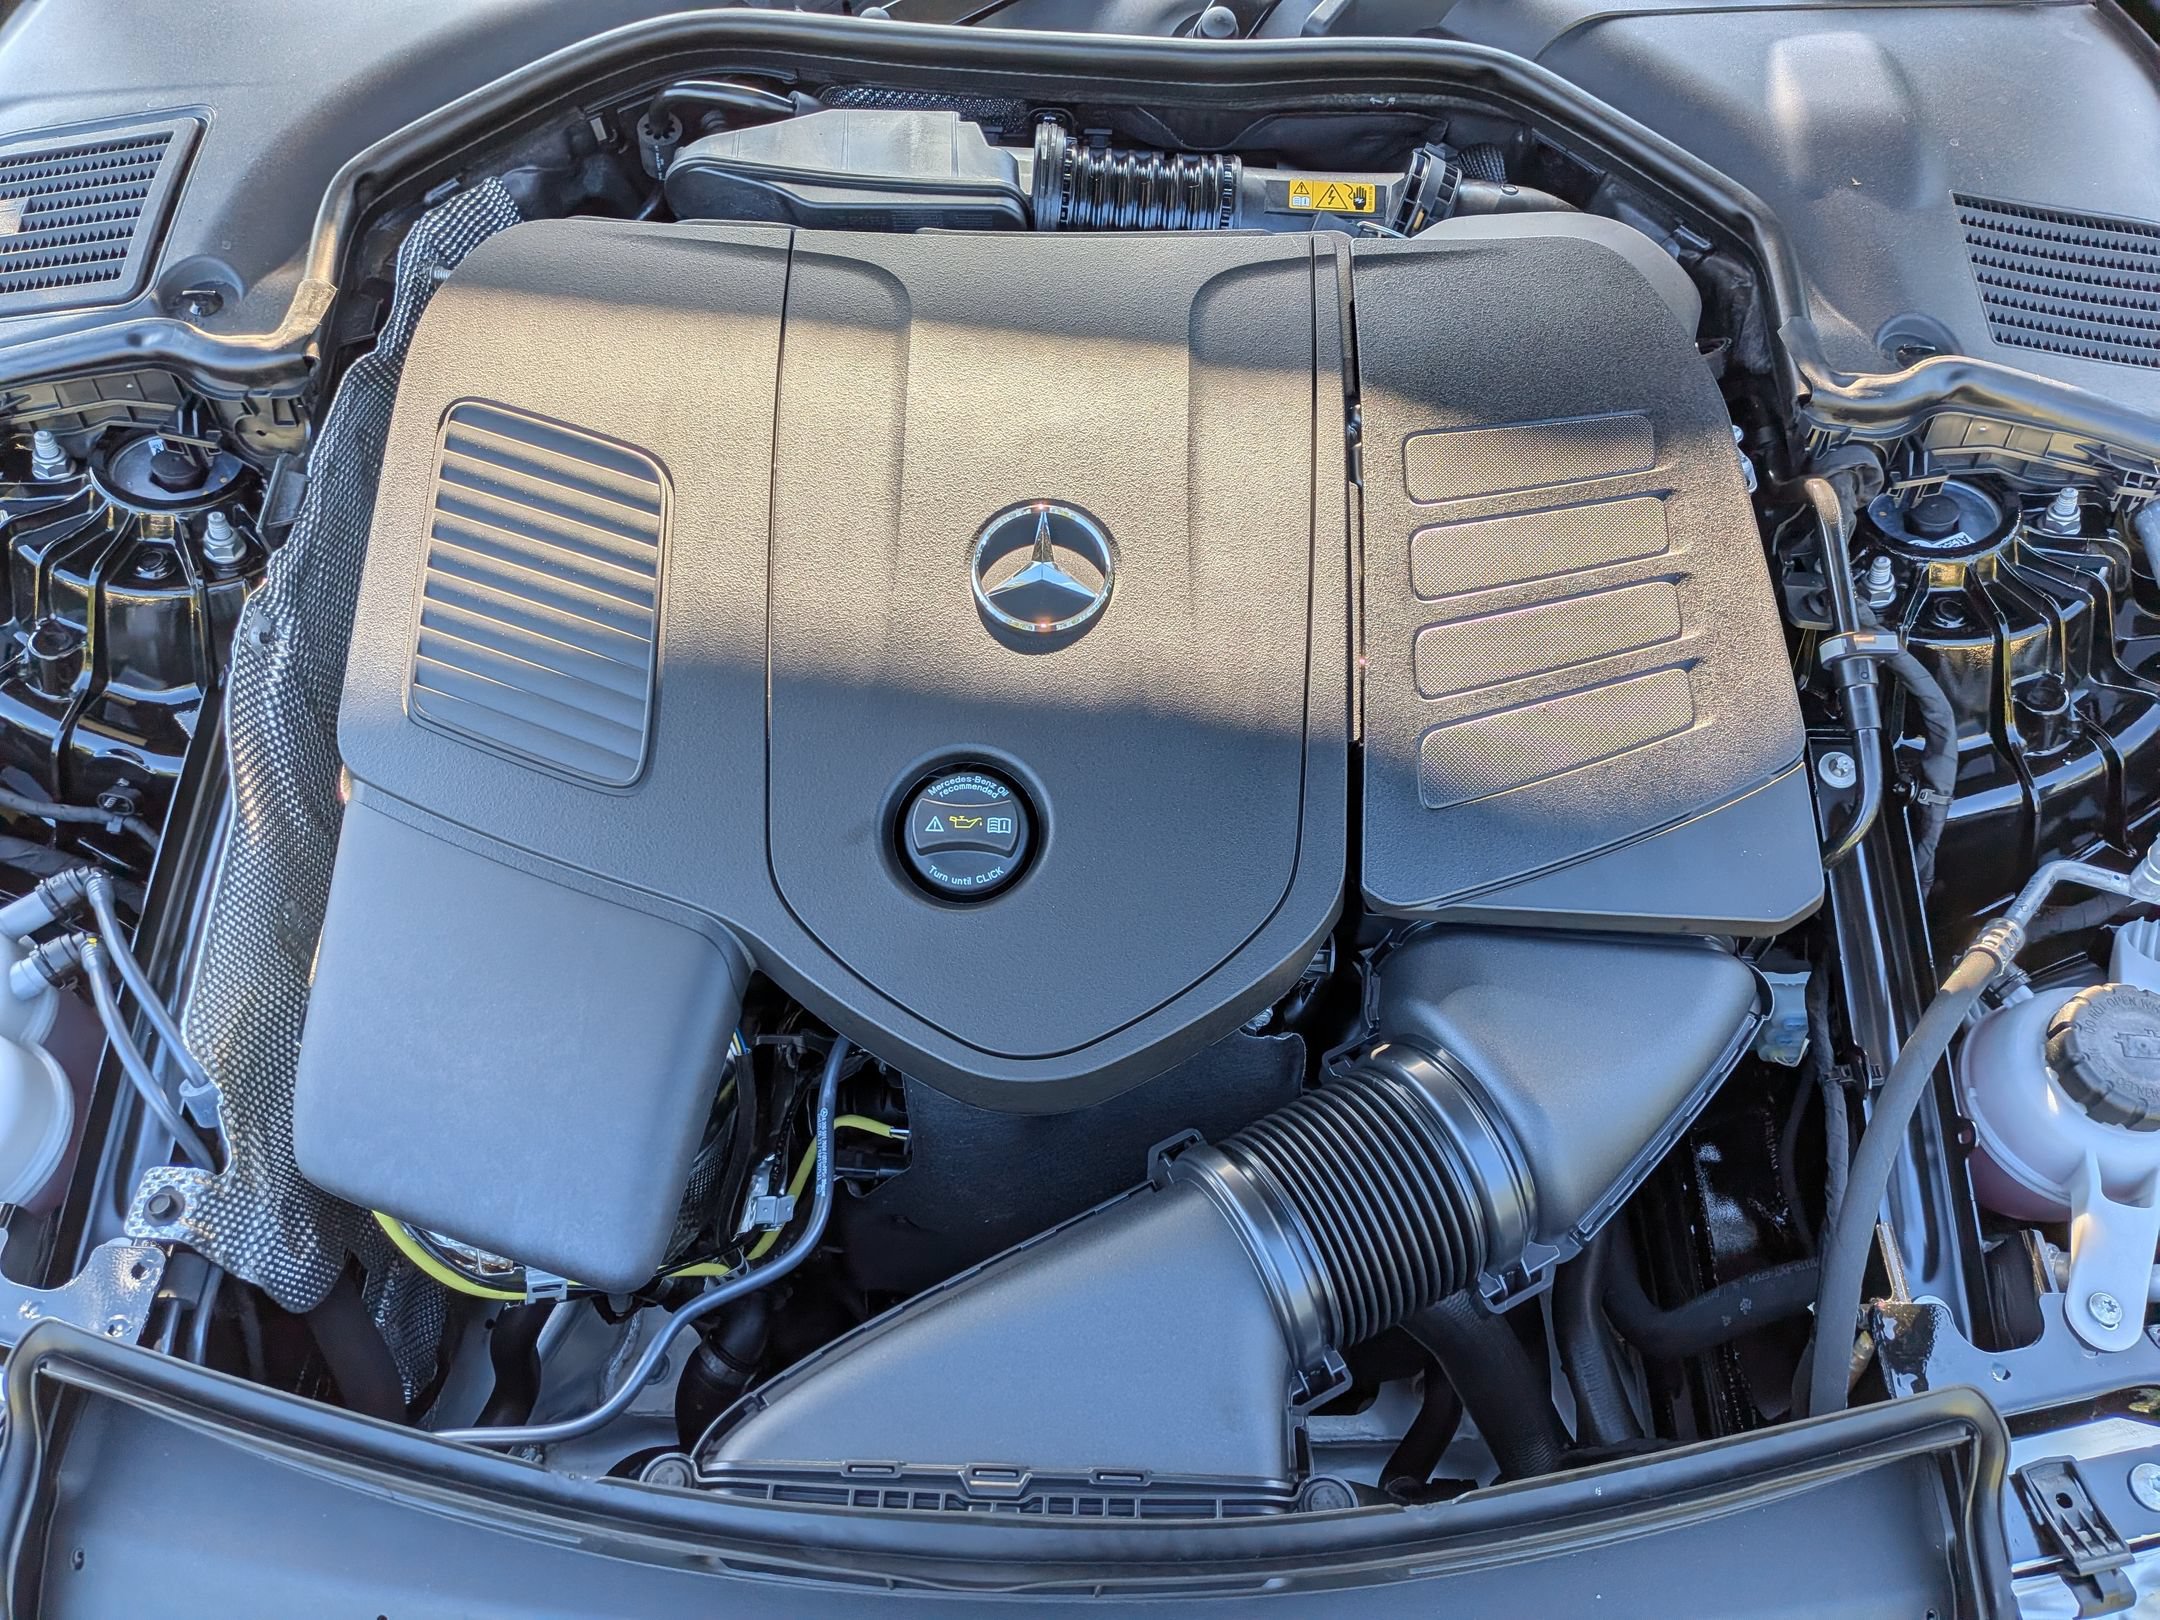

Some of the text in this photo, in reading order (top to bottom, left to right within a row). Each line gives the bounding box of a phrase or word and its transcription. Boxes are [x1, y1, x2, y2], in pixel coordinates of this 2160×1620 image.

[927, 776, 1009, 797] Mercedes-Benz Oil
[939, 783, 999, 799] recommended
[929, 865, 1004, 885] Turn until CLICK
